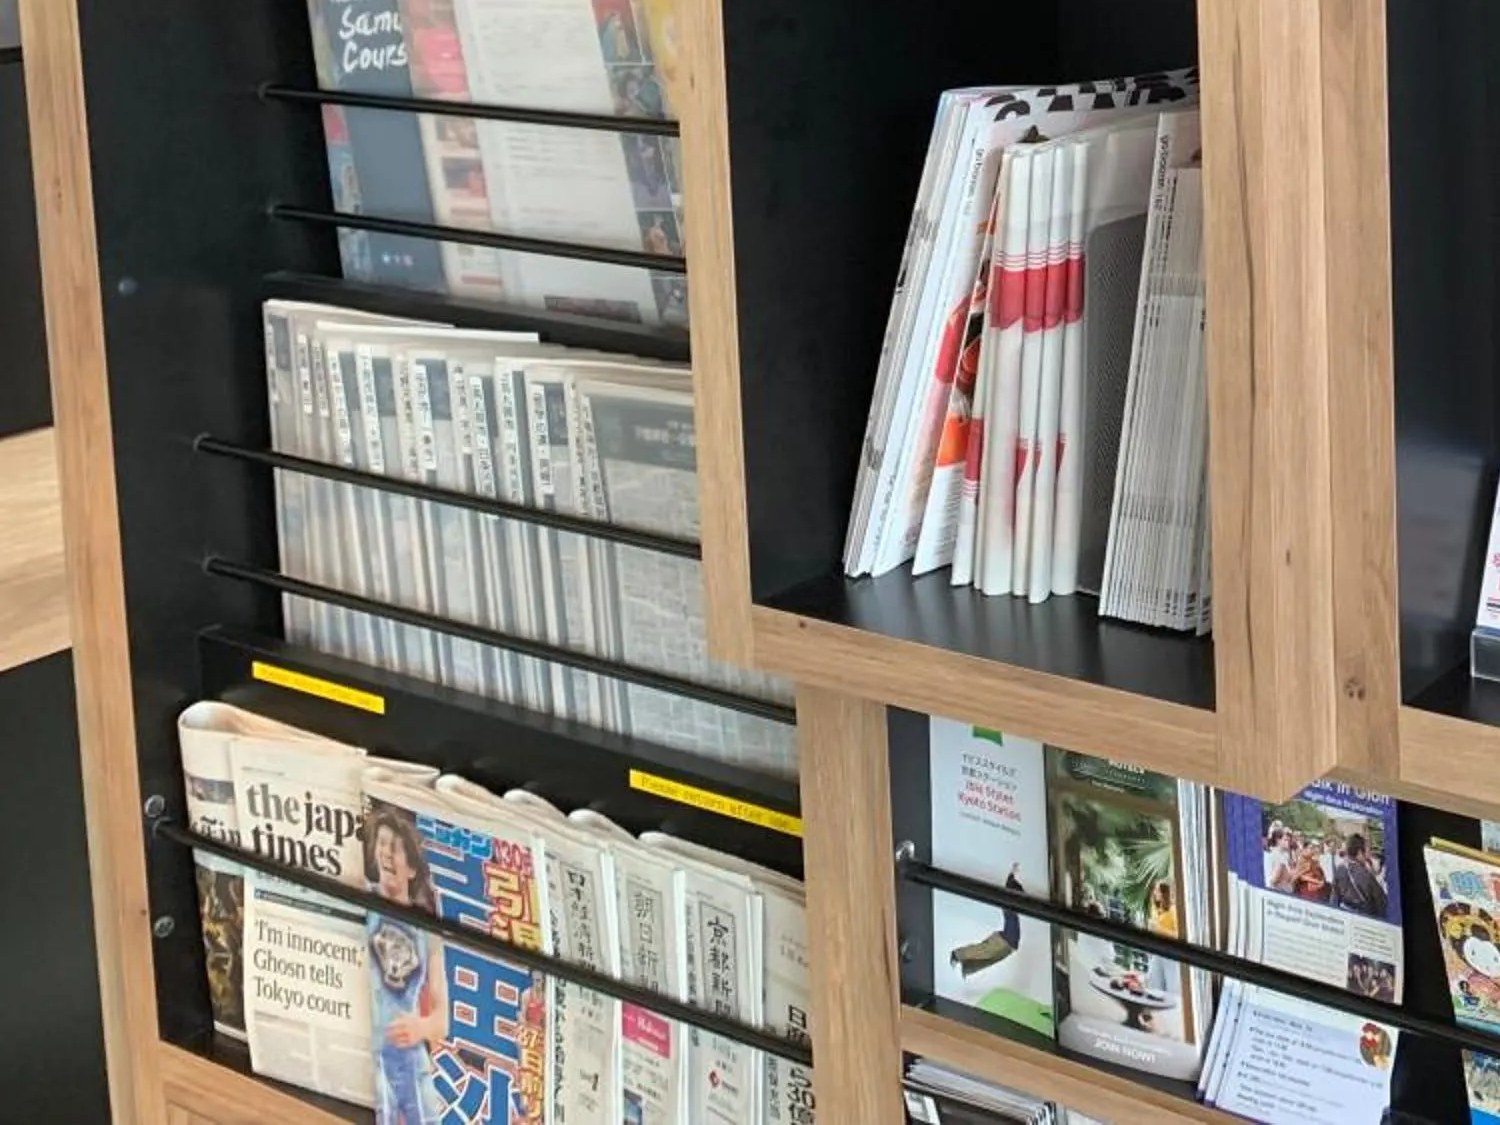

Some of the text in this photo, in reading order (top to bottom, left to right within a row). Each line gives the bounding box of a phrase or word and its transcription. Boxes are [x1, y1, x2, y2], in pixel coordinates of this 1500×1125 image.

[246, 782, 300, 825] the
[251, 823, 342, 876] times
[253, 948, 343, 989] Ghosn tells
[252, 975, 352, 1020] Tokyo court
